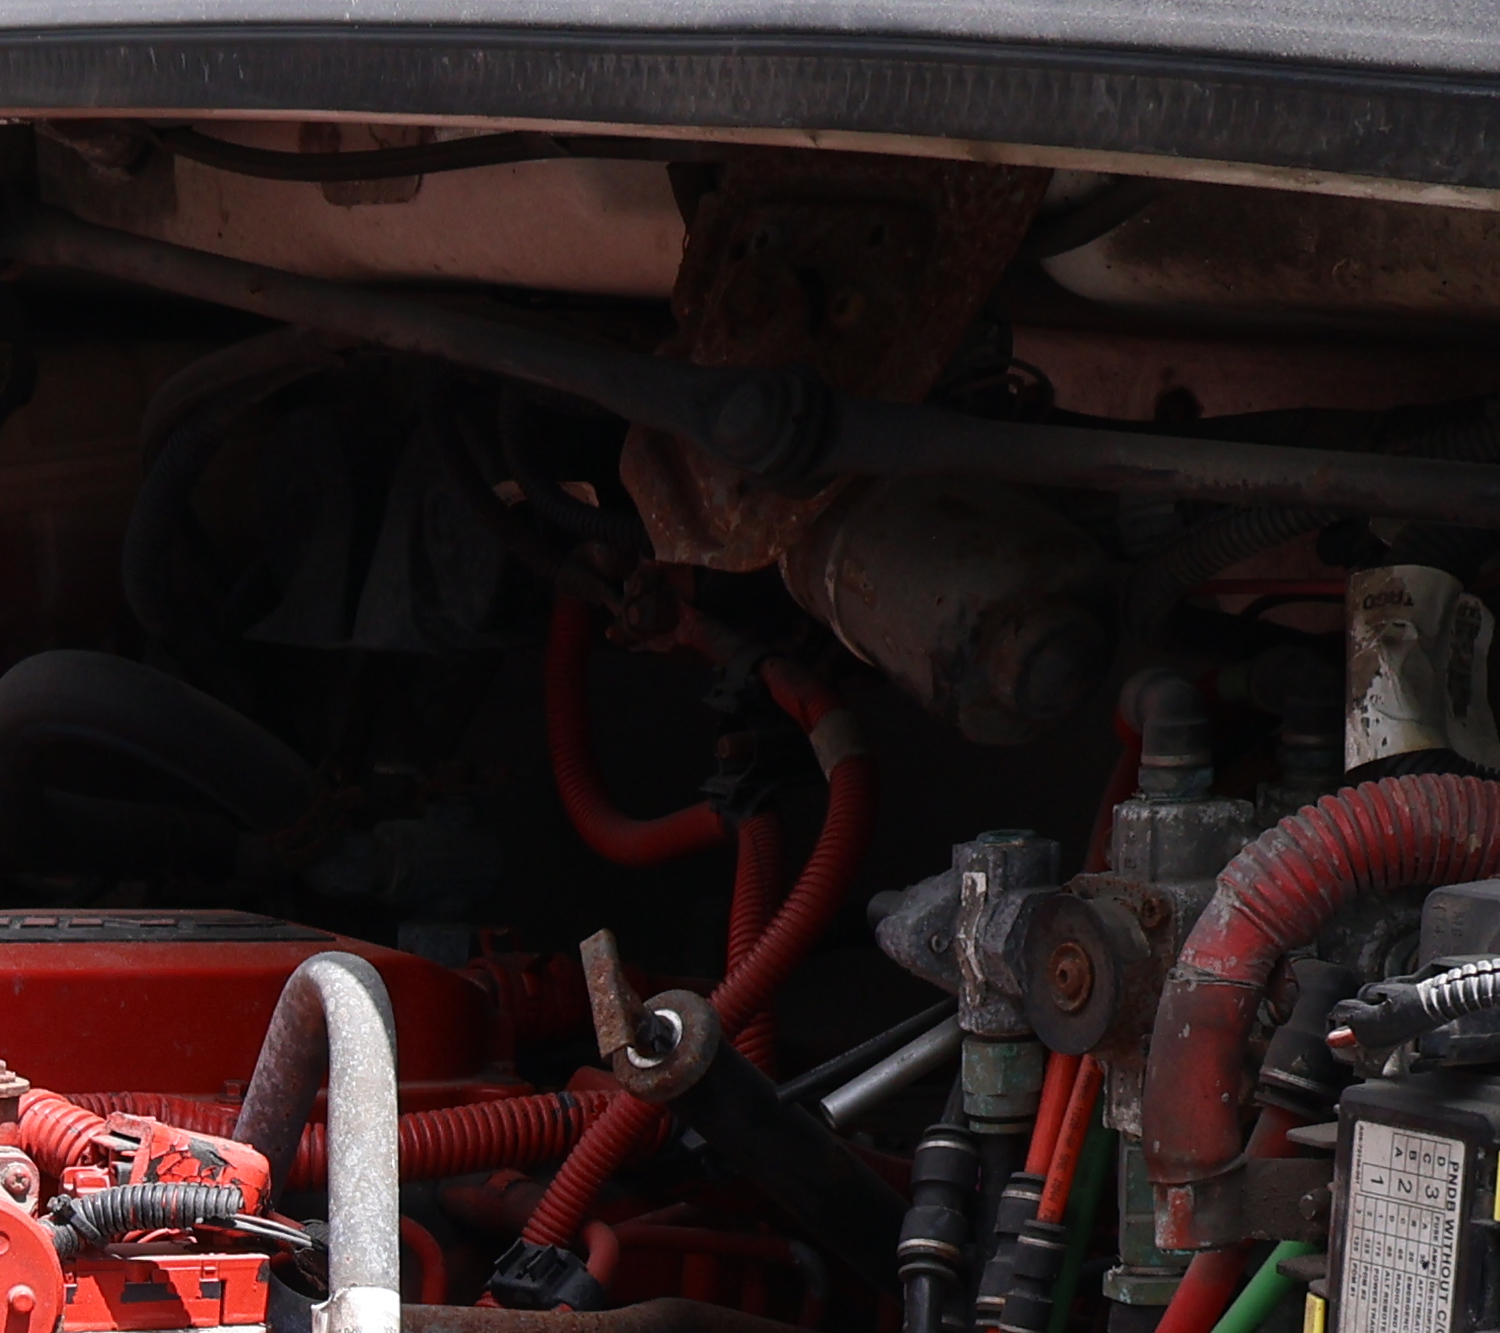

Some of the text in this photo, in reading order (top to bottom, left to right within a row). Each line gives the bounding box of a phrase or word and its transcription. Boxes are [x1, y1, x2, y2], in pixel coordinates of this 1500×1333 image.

[1395, 1147, 1403, 1157] A
[1409, 1151, 1417, 1160] B
[1423, 1153, 1431, 1164] C
[1437, 1156, 1446, 1166] D
[1371, 1176, 1384, 1184] 1
[1398, 1178, 1412, 1193] 2
[1447, 1161, 1459, 1211] PNDB
[1425, 1185, 1439, 1199] 3
[1439, 1219, 1454, 1303] WITHOUT
[1371, 1268, 1379, 1304] POWER
[1380, 1292, 1389, 1333] REMOTE
